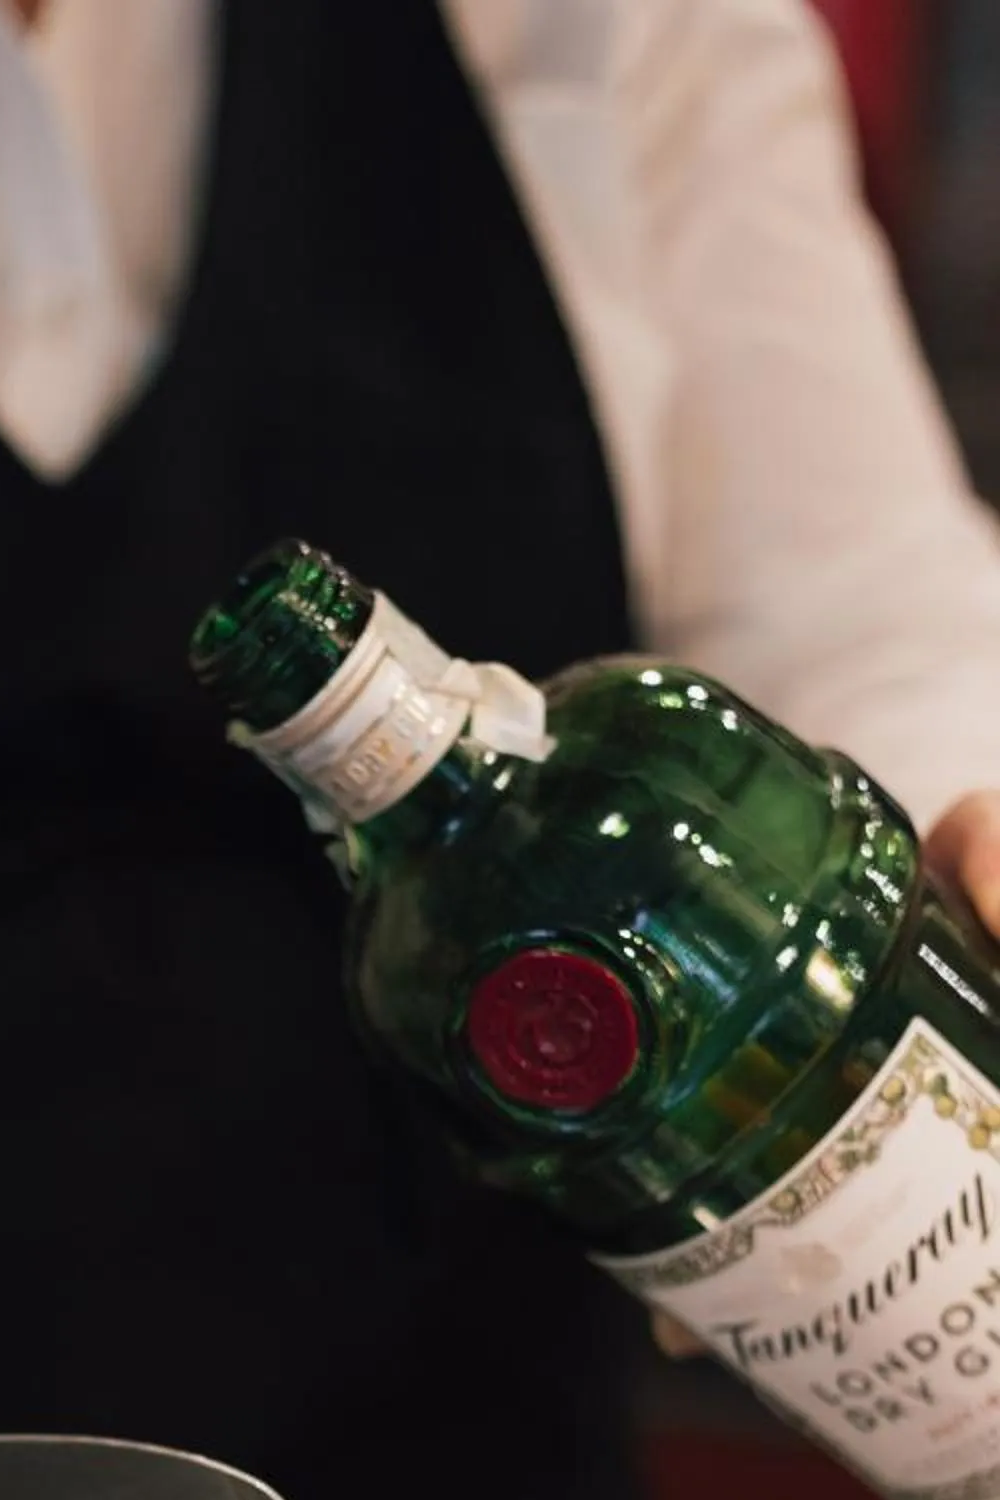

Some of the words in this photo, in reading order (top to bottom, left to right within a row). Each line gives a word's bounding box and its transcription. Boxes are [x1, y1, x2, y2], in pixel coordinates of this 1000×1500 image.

[710, 1172, 992, 1369] Tanqueray
[808, 1266, 1000, 1408] LONDON
[843, 1376, 935, 1434] DRY
